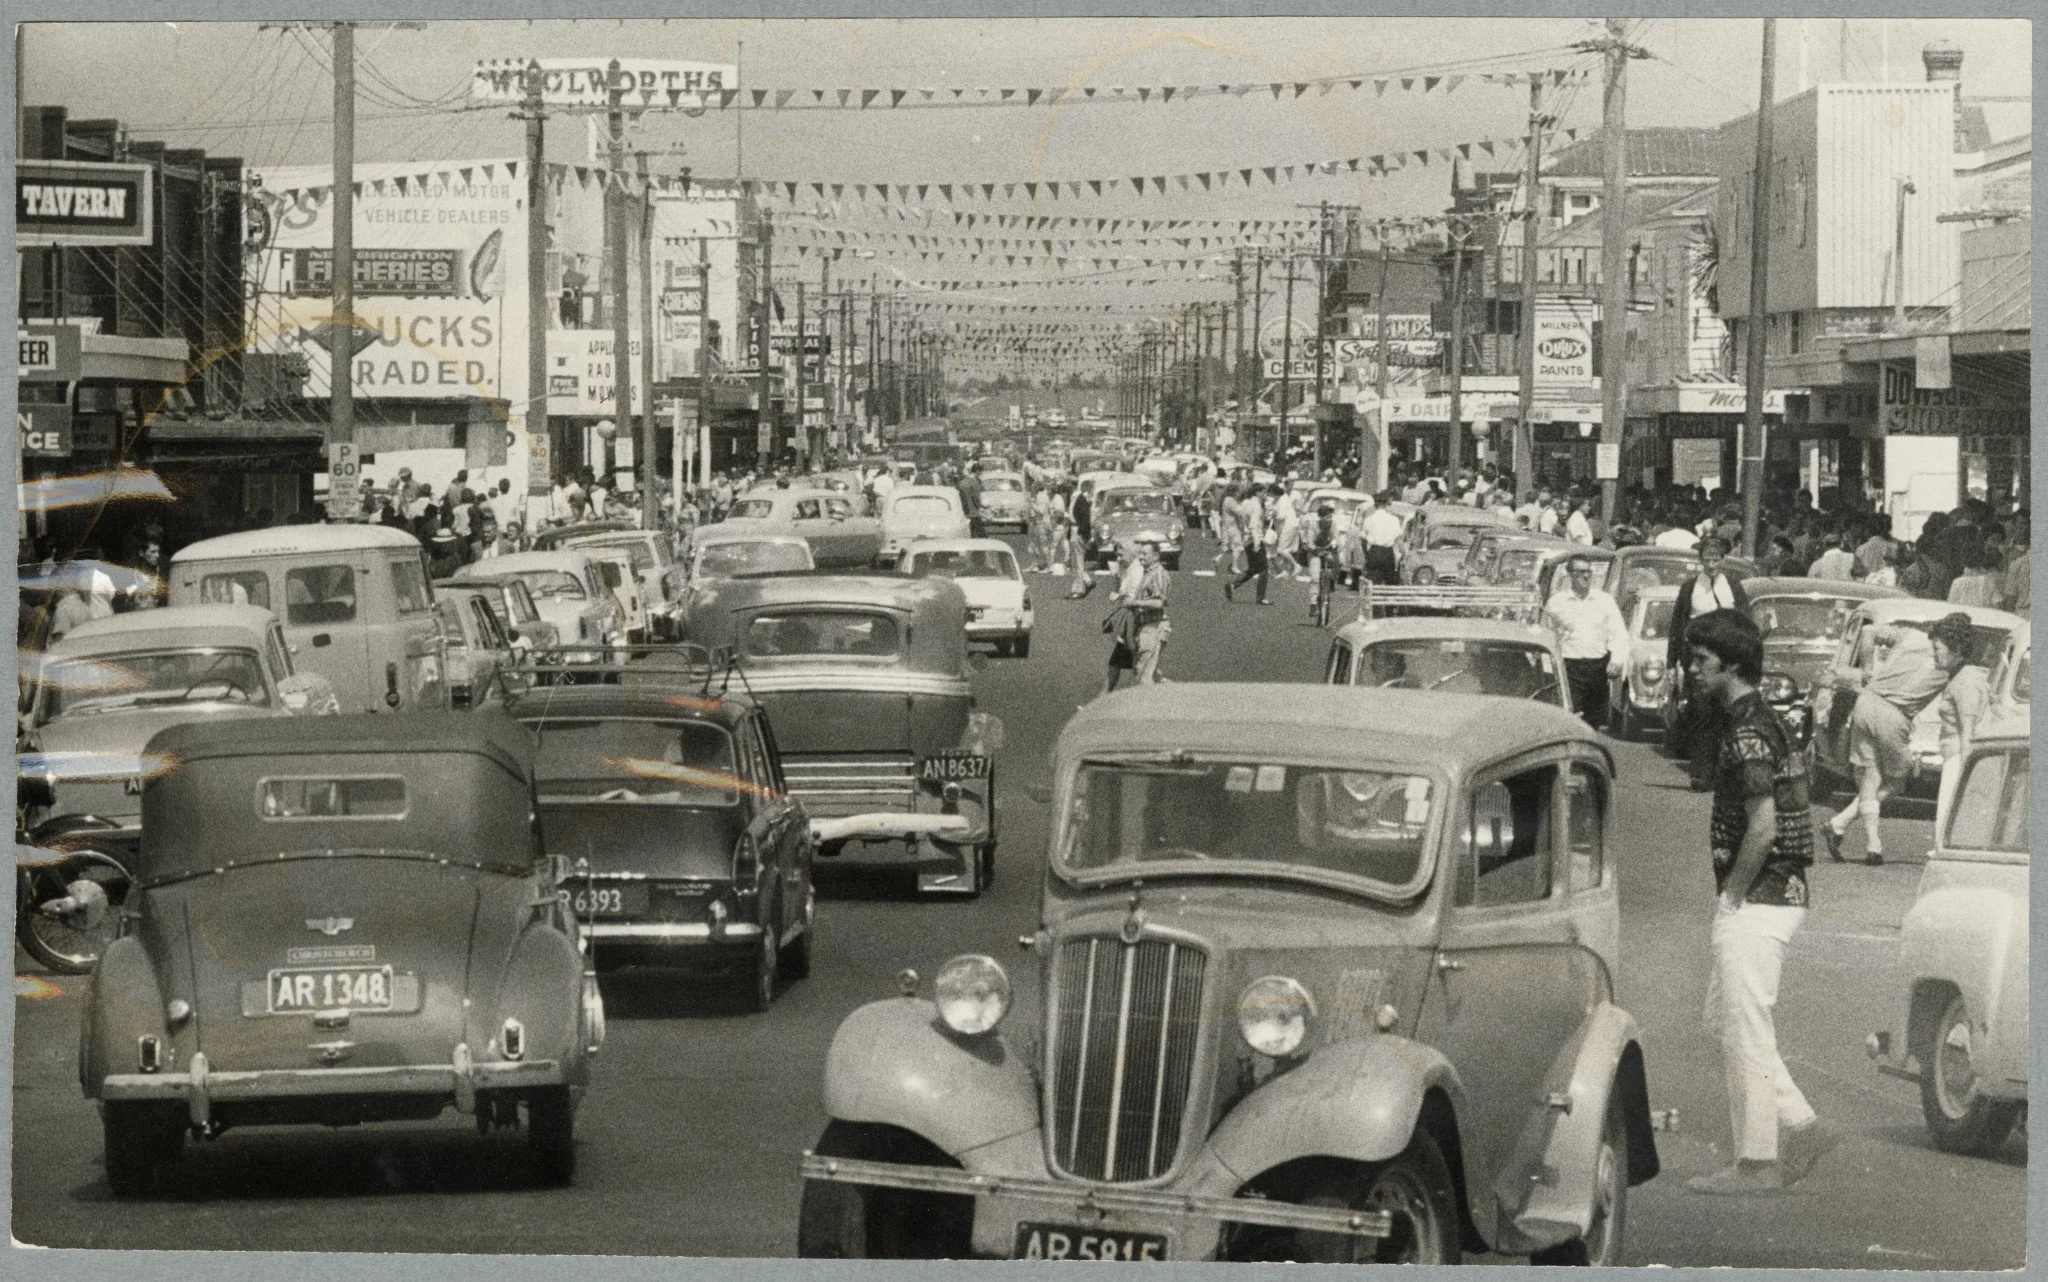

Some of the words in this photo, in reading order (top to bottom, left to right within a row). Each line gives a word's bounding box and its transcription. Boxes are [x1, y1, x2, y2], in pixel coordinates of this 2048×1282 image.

[22, 184, 127, 219] TAVERN
[365, 209, 431, 224] VEHICLE
[438, 209, 510, 224] DEALERS
[307, 260, 450, 281] FIHERIES
[377, 315, 493, 348] UCKS
[357, 360, 493, 386] RADED.
[1540, 365, 1584, 376] PAINTS
[340, 446, 351, 462] P
[333, 463, 355, 476] 60
[923, 759, 946, 779] AN
[948, 757, 984, 777] 8637
[575, 889, 621, 912] 6393
[276, 975, 316, 1006] AR
[322, 972, 385, 1006] 1348
